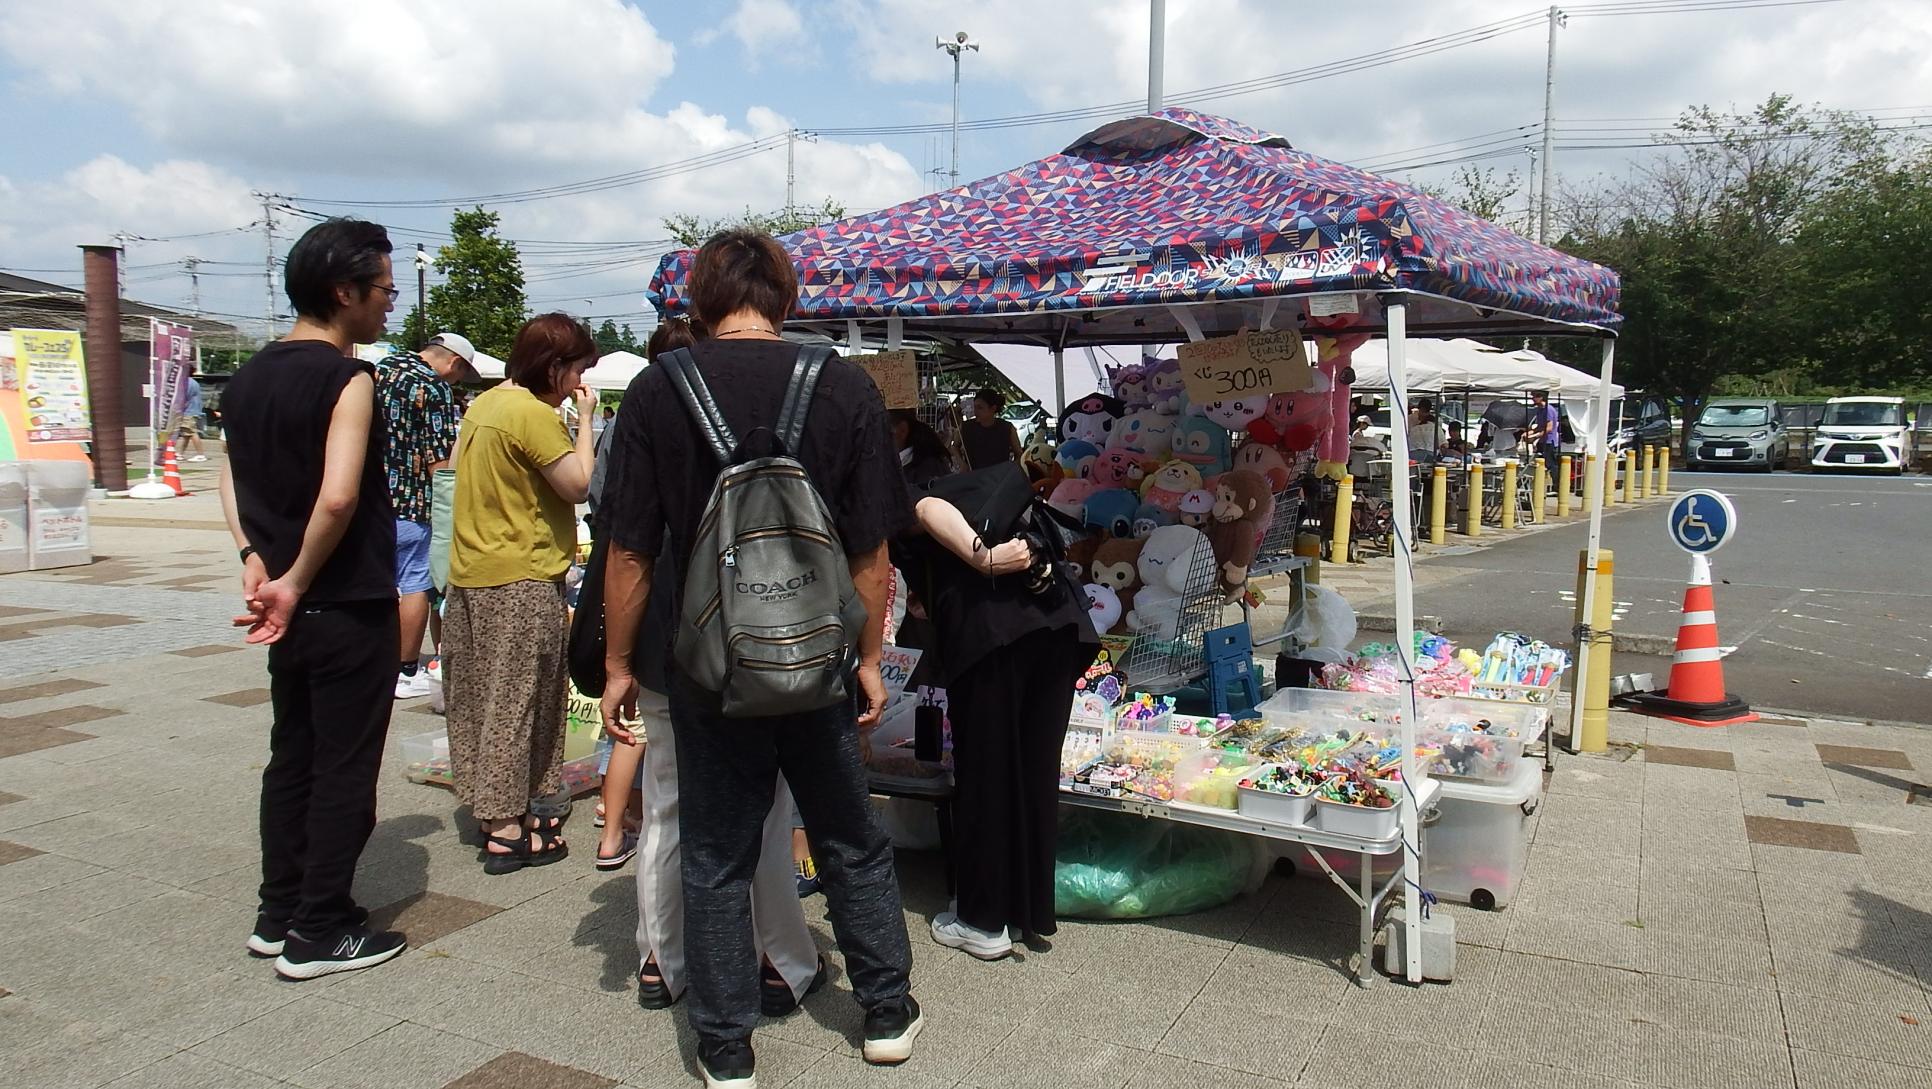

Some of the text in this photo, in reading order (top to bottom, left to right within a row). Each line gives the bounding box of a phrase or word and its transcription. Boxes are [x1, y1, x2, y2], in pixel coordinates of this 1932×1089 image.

[1105, 268, 1199, 291] FIELDOOR
[1214, 367, 1273, 394] 300円
[736, 568, 817, 595] COACH
[760, 591, 799, 602] NEW YORK
